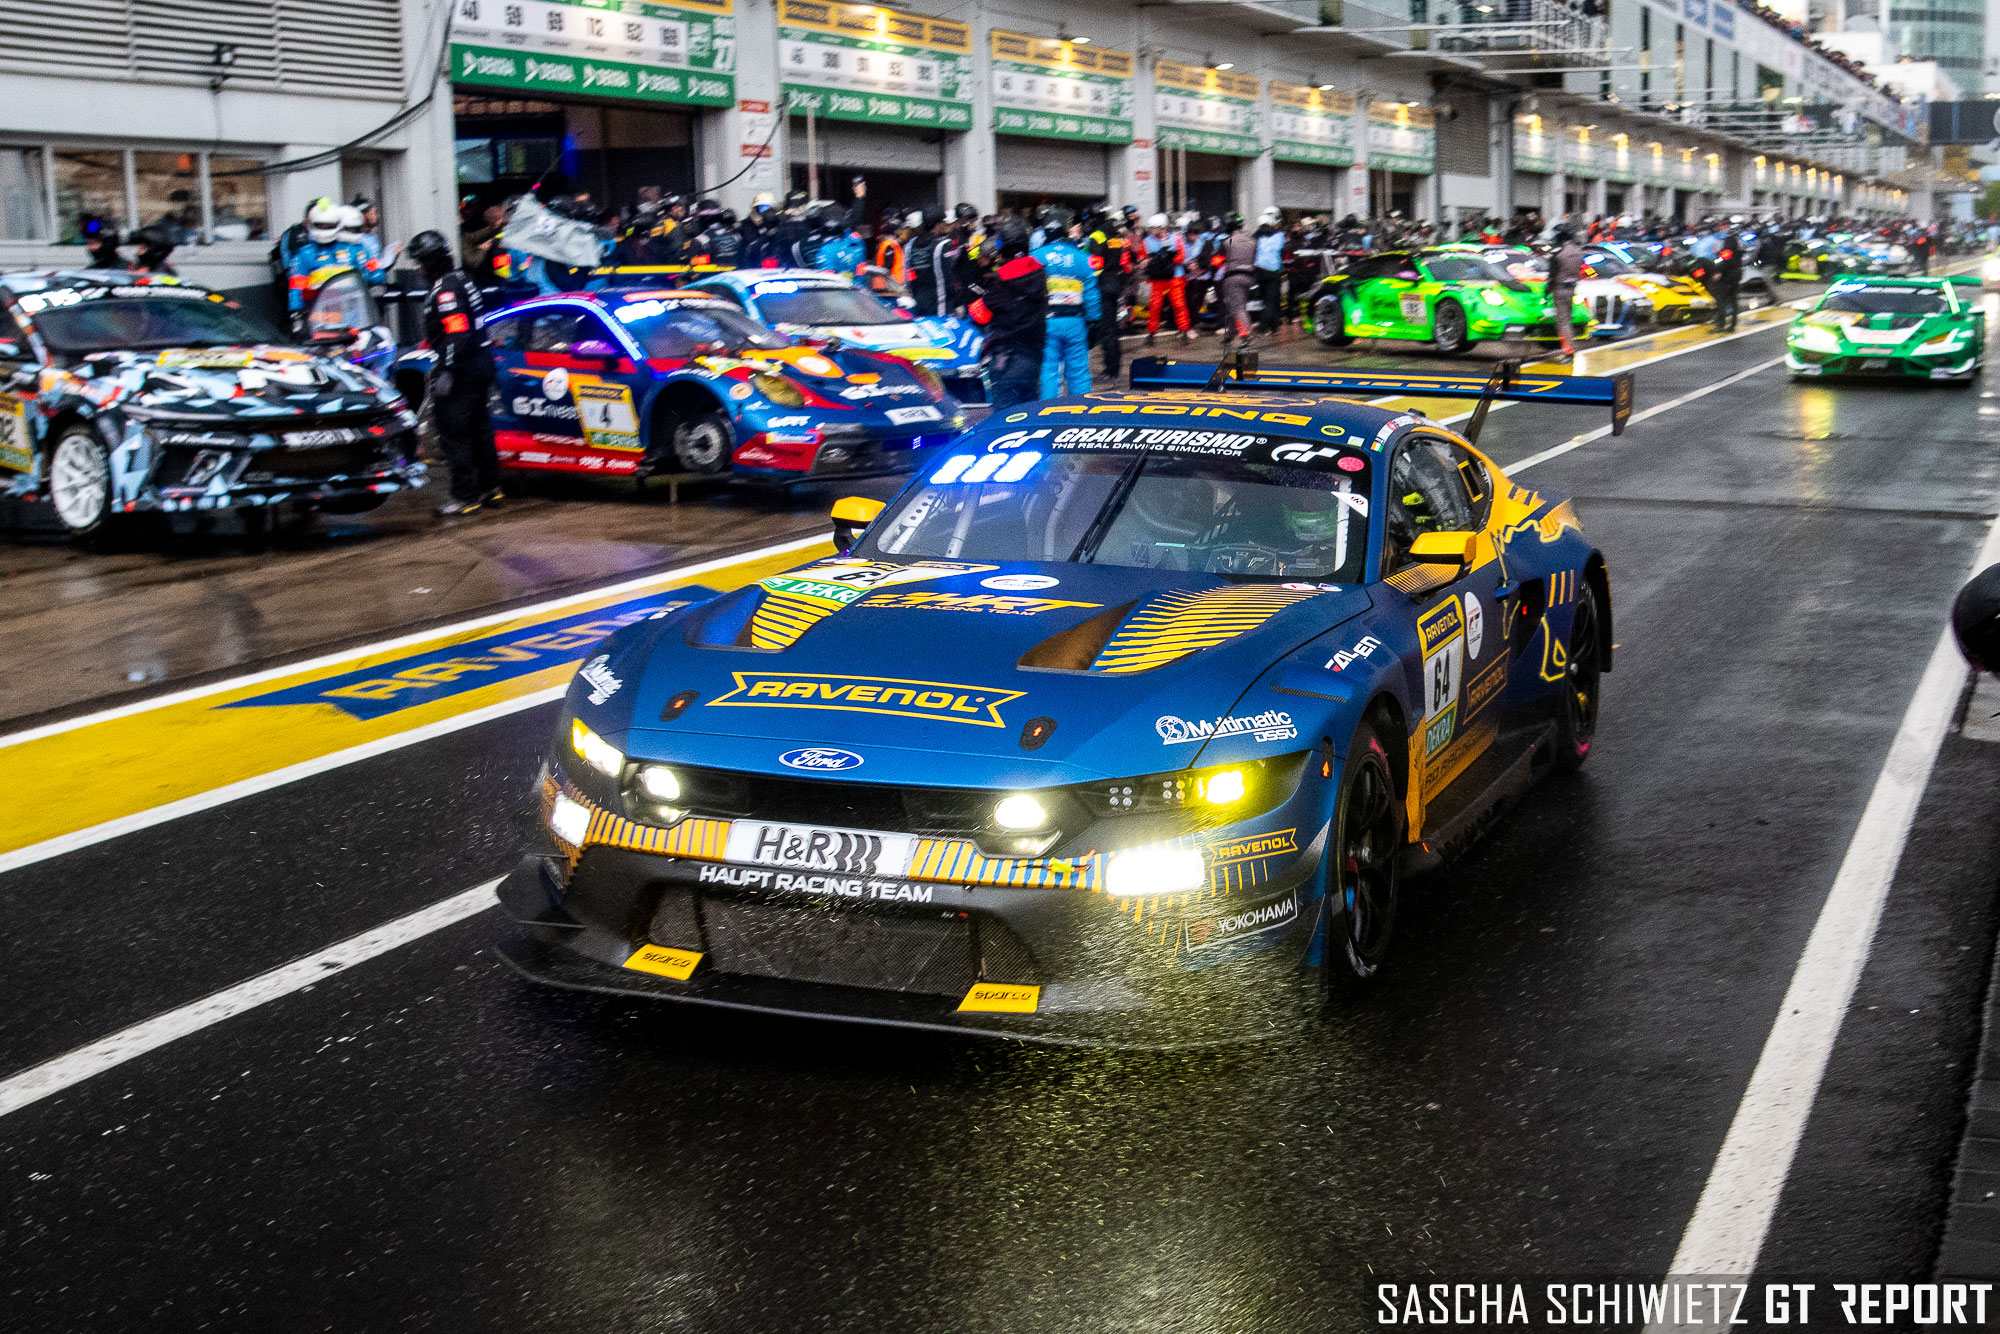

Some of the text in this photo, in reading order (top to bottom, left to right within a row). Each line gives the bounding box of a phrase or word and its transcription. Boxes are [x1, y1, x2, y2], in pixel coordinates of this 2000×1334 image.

[1038, 405, 1313, 427] RACING
[1053, 427, 1136, 444] GRAN
[1051, 442, 1242, 457] THE REAL DRIVING SIMULATOR
[855, 602, 1037, 617] HAUPT RACING TEAM
[1425, 611, 1458, 643] RAVENOL
[1433, 649, 1450, 712] 64
[747, 681, 982, 713] RAVENOL
[1186, 709, 1292, 738] Multimatic
[1253, 727, 1298, 743] DSSV
[792, 750, 848, 769] Ford
[753, 826, 834, 868] H&R
[1218, 836, 1290, 859] RAVENOL
[699, 865, 933, 903] HAUPT RACING TEAM
[1220, 898, 1294, 935] YOKOHAMA
[642, 951, 693, 969] sparco
[973, 987, 1032, 1003] sparco
